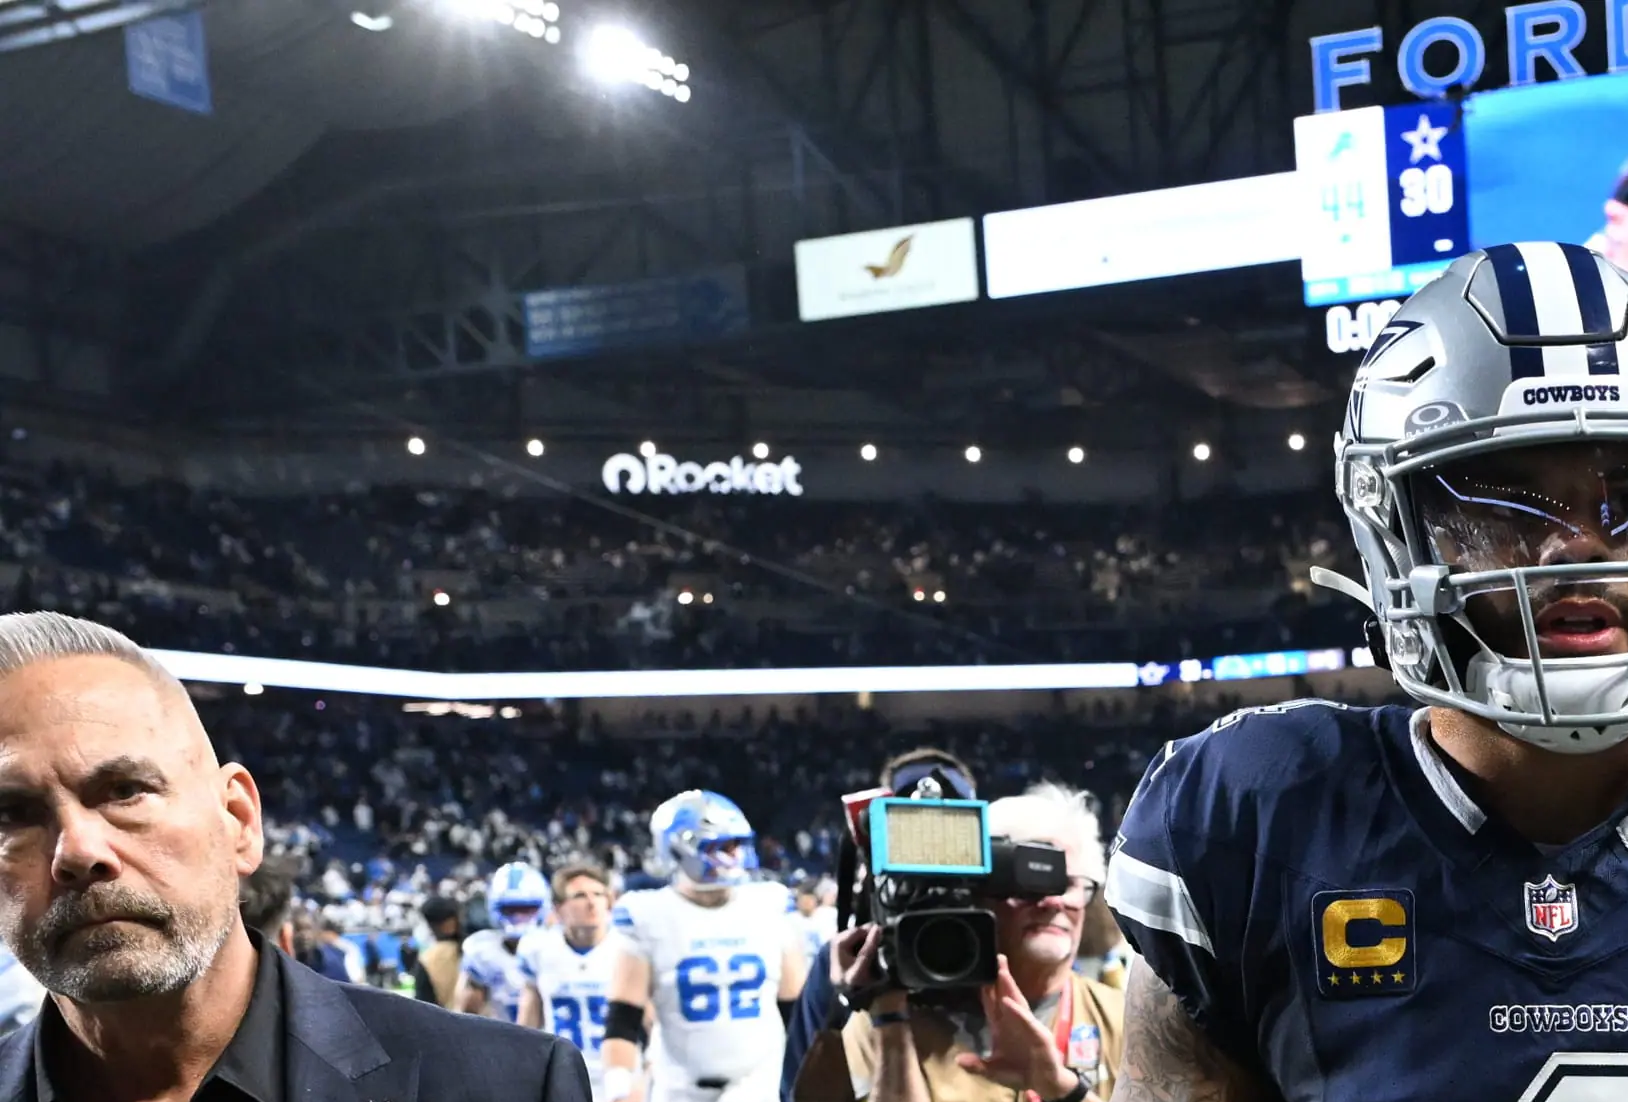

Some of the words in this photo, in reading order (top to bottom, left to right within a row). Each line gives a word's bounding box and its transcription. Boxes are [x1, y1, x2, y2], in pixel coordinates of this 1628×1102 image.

[1398, 164, 1454, 218] 30
[1523, 384, 1621, 405] COWBOYS
[645, 453, 803, 497] Rocket
[1322, 897, 1407, 969] C
[1534, 902, 1573, 928] NFL
[676, 953, 766, 1023] 62
